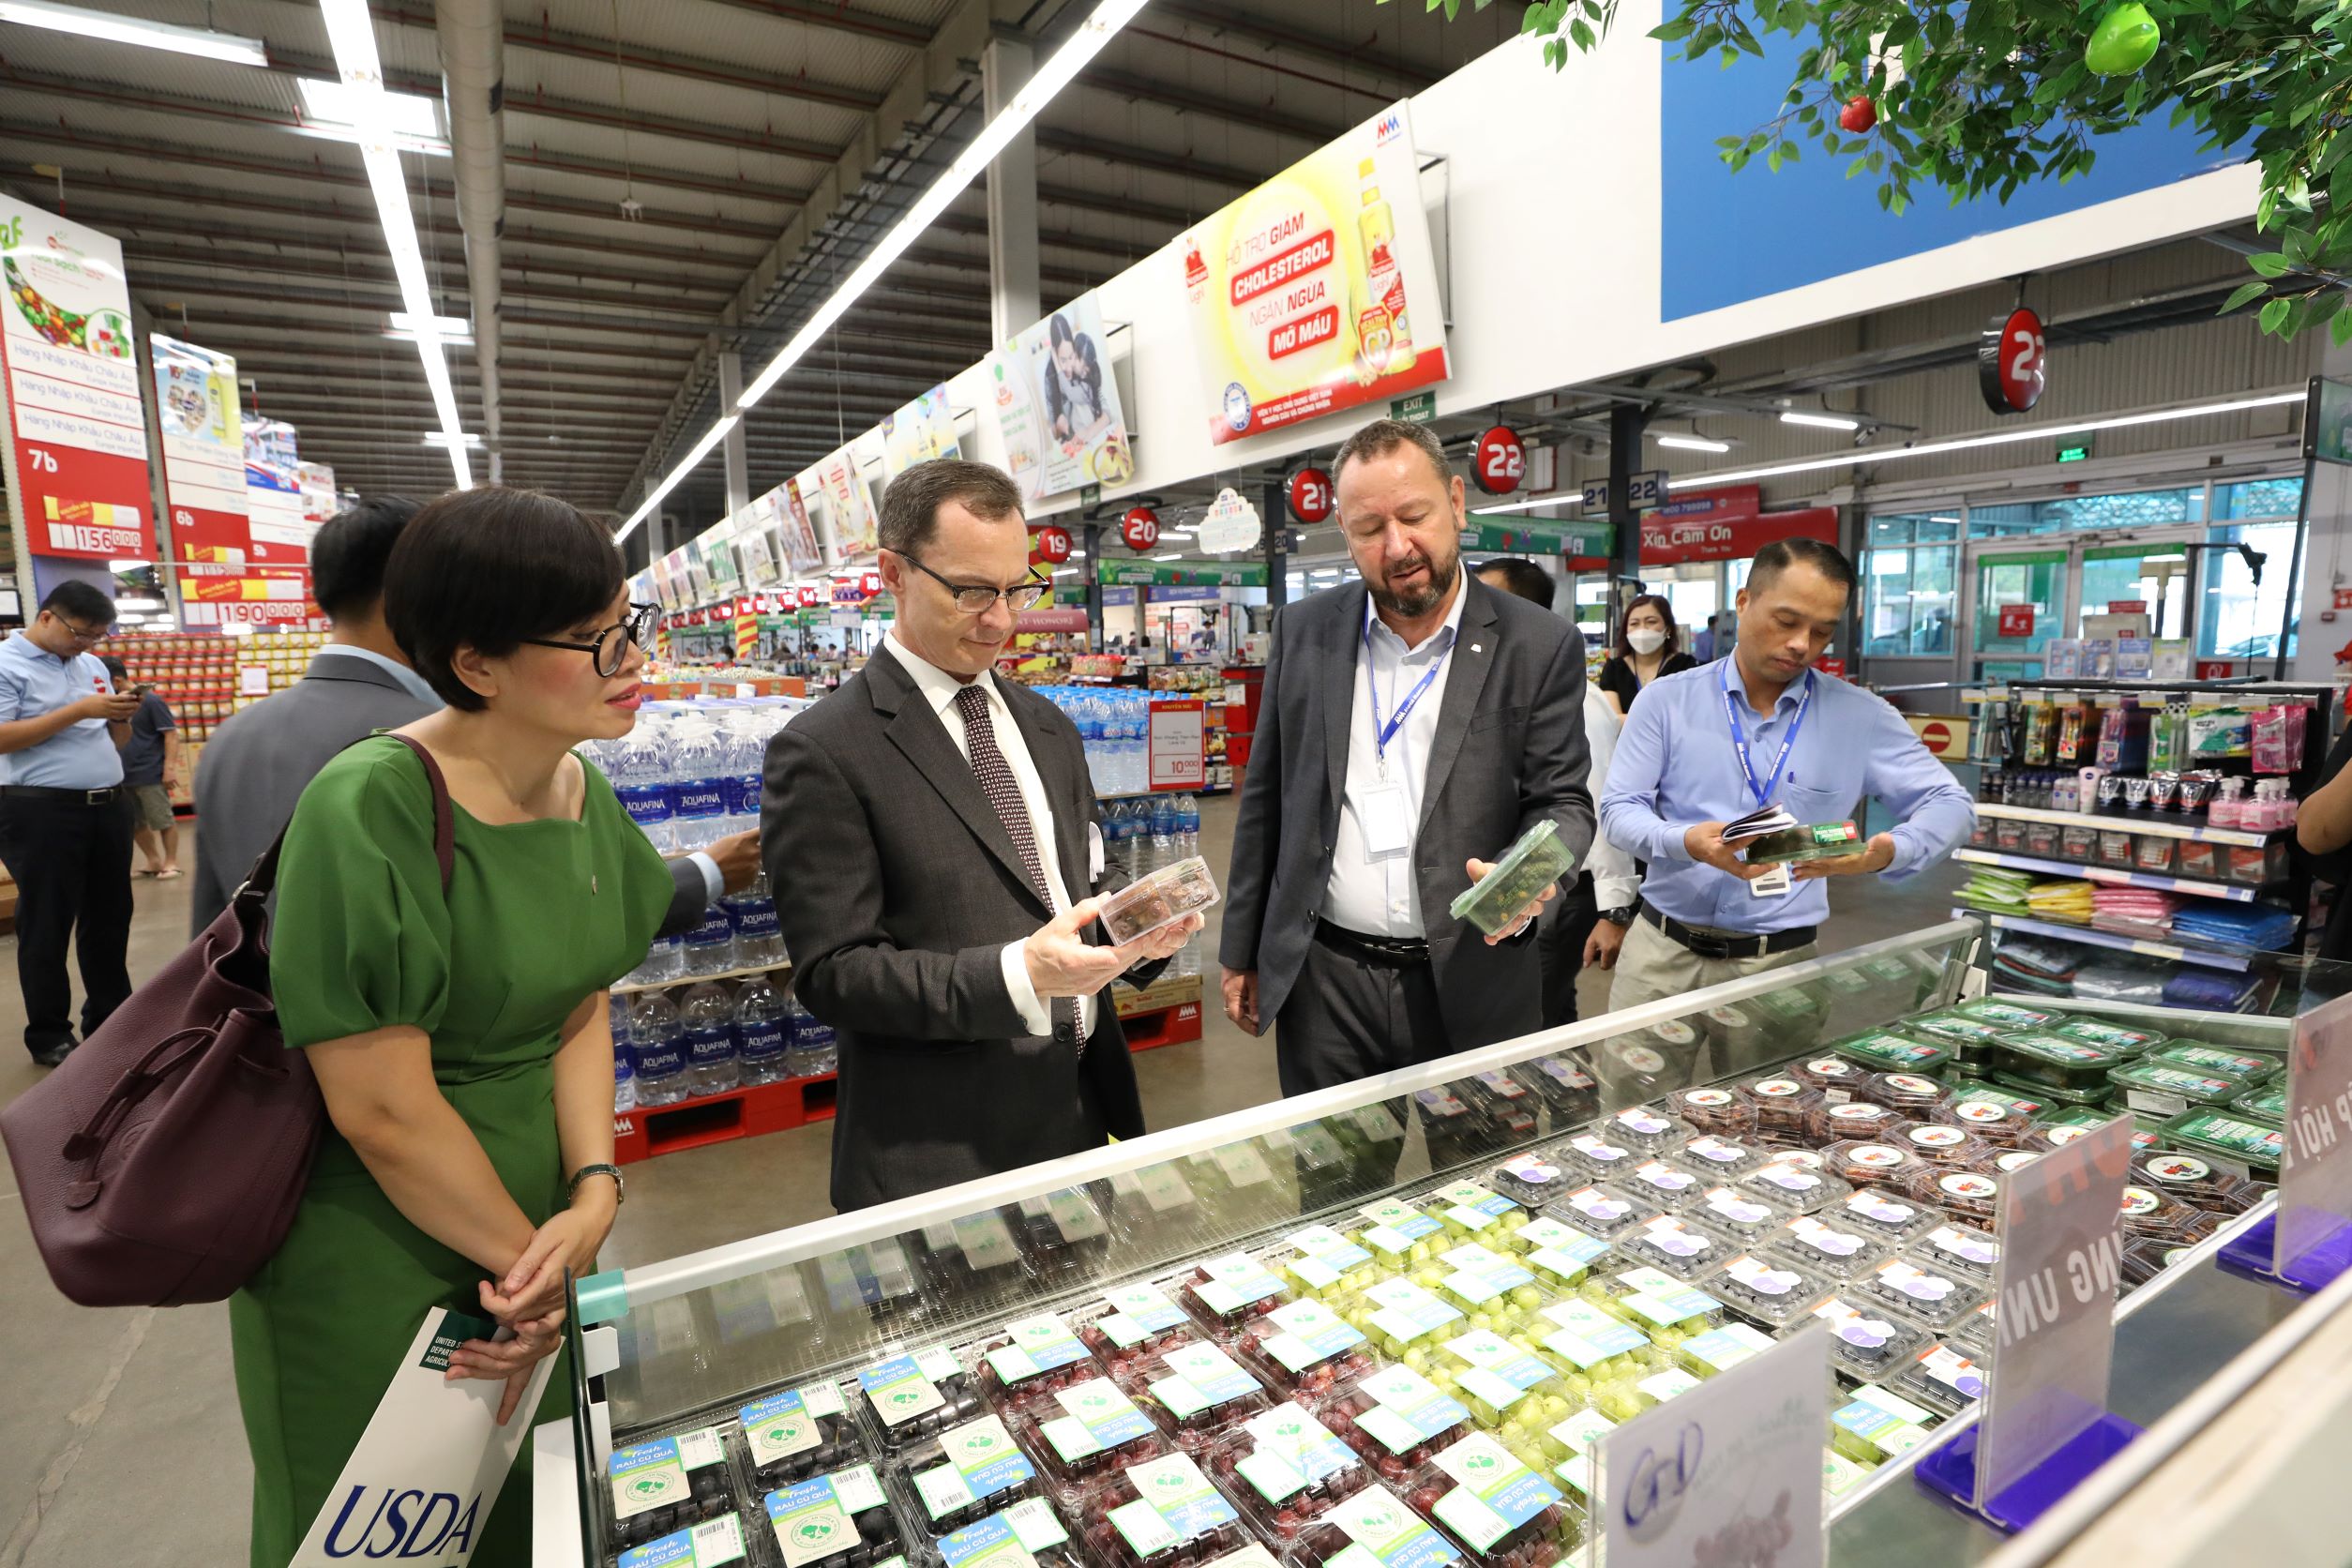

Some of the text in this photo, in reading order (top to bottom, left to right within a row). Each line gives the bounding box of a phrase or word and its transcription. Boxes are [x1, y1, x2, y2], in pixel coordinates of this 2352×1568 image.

[1234, 237, 1330, 300] CHOLESTEROL
[1274, 313, 1332, 354] MỠ MÁU
[1403, 396, 1424, 412] EXIT
[28, 448, 59, 474] 7b
[1487, 444, 1522, 477] 22
[1303, 482, 1328, 511] 21
[1584, 485, 1607, 507] 21
[1630, 479, 1657, 501] 22
[175, 509, 195, 526] 6b
[1128, 517, 1156, 542] 20
[80, 528, 113, 550] 156
[1049, 534, 1067, 554] 19
[1274, 535, 1289, 549] 20
[1643, 532, 1666, 548] Xin
[223, 603, 264, 624] 190
[1171, 761, 1184, 774] 10
[626, 798, 666, 812] AQUAFINA
[682, 792, 721, 807] AQUAFINA
[693, 1038, 731, 1054] AQUAFINA
[748, 1033, 782, 1048] AQUAFINA
[642, 1052, 679, 1069] AQUAFINA
[435, 1336, 457, 1348] UNITED
[430, 1346, 453, 1357] DEPART
[425, 1355, 451, 1367] AGRICUL
[747, 1410, 766, 1422] RAU
[632, 1445, 662, 1458] Fresh
[616, 1459, 637, 1470] RAU
[1005, 1457, 1024, 1468] RAU
[788, 1485, 820, 1499] Fresh
[774, 1500, 796, 1513] RAU
[323, 1485, 483, 1559] USDA
[962, 1524, 994, 1542] Fresh
[644, 1540, 679, 1558] Fresh
[950, 1545, 972, 1560] RAU
[626, 1559, 650, 1568] RAU
